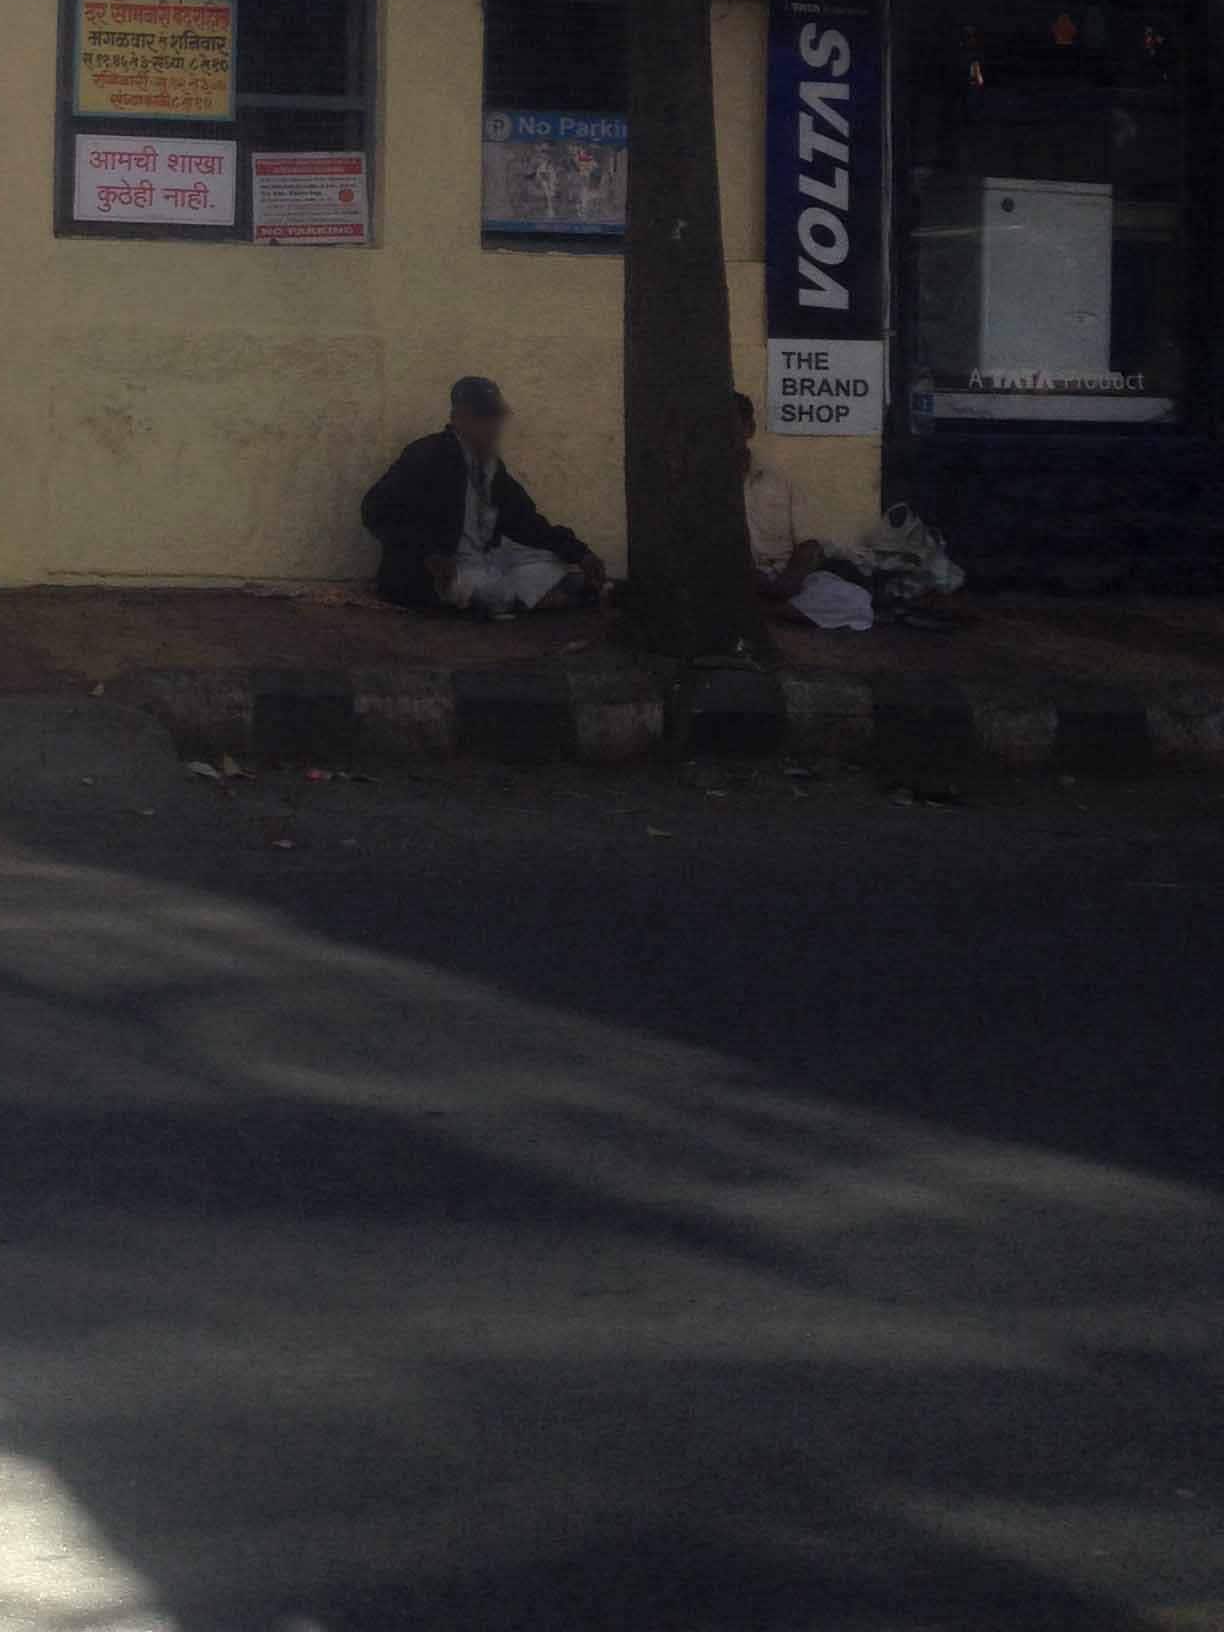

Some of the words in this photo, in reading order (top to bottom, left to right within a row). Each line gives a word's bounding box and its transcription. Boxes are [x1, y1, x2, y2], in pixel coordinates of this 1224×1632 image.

[519, 115, 552, 135] No
[88, 145, 159, 175] आमची
[167, 153, 224, 177] शाखा
[797, 22, 851, 310] VOLTAS
[95, 179, 155, 213] कुठेही
[781, 351, 830, 370] THE
[781, 378, 870, 398] BRAND
[969, 367, 984, 389] A
[780, 404, 850, 424] SHOP
